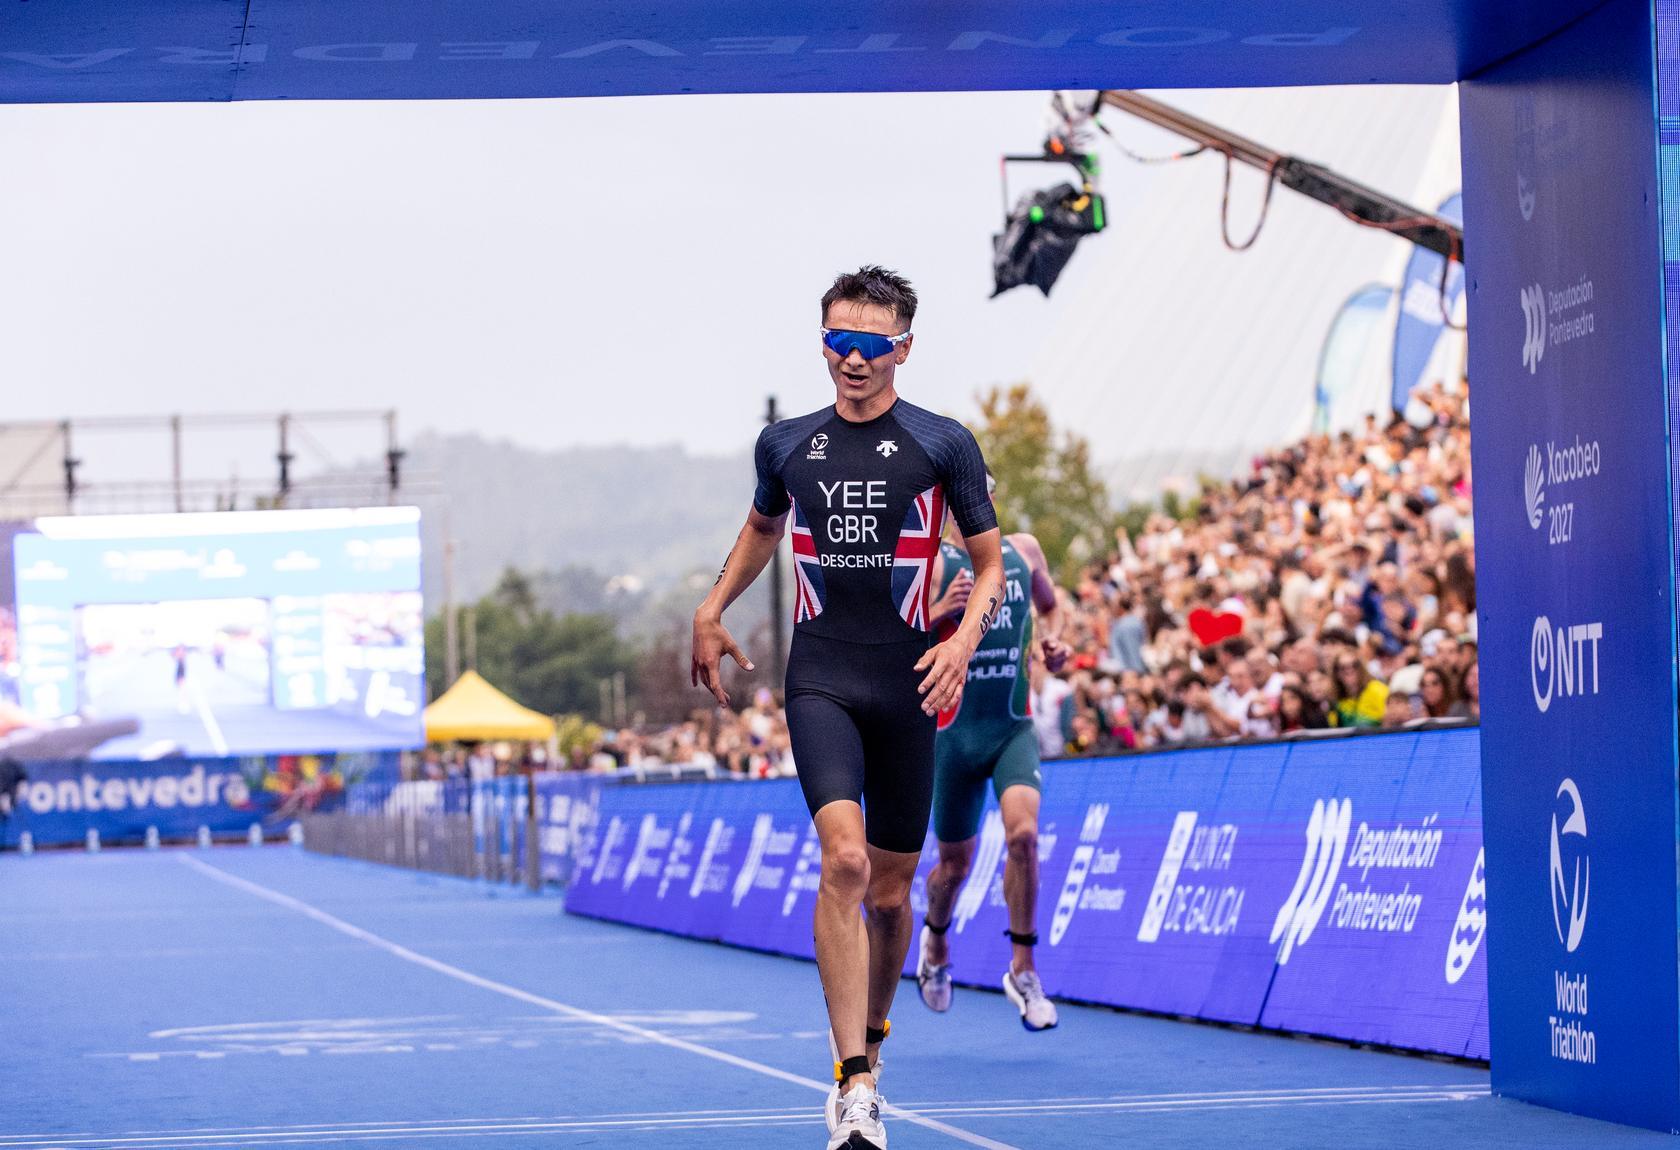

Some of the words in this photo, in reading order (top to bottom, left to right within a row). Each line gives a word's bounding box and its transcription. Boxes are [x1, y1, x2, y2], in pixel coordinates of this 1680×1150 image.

[1549, 273, 1594, 318] Deputación
[1550, 310, 1594, 346] Pontevedra
[1547, 435, 1600, 485] Xacobeo
[817, 480, 887, 508] YEE
[827, 514, 879, 543] GBR
[1549, 502, 1574, 545] 2027
[821, 554, 892, 568] DESCENTE
[1557, 622, 1603, 697] NTT
[1347, 812, 1443, 883] Deputación
[1328, 882, 1423, 932] Pontevedra
[1555, 970, 1588, 1015] World
[1549, 1016, 1596, 1065] Triathlon
